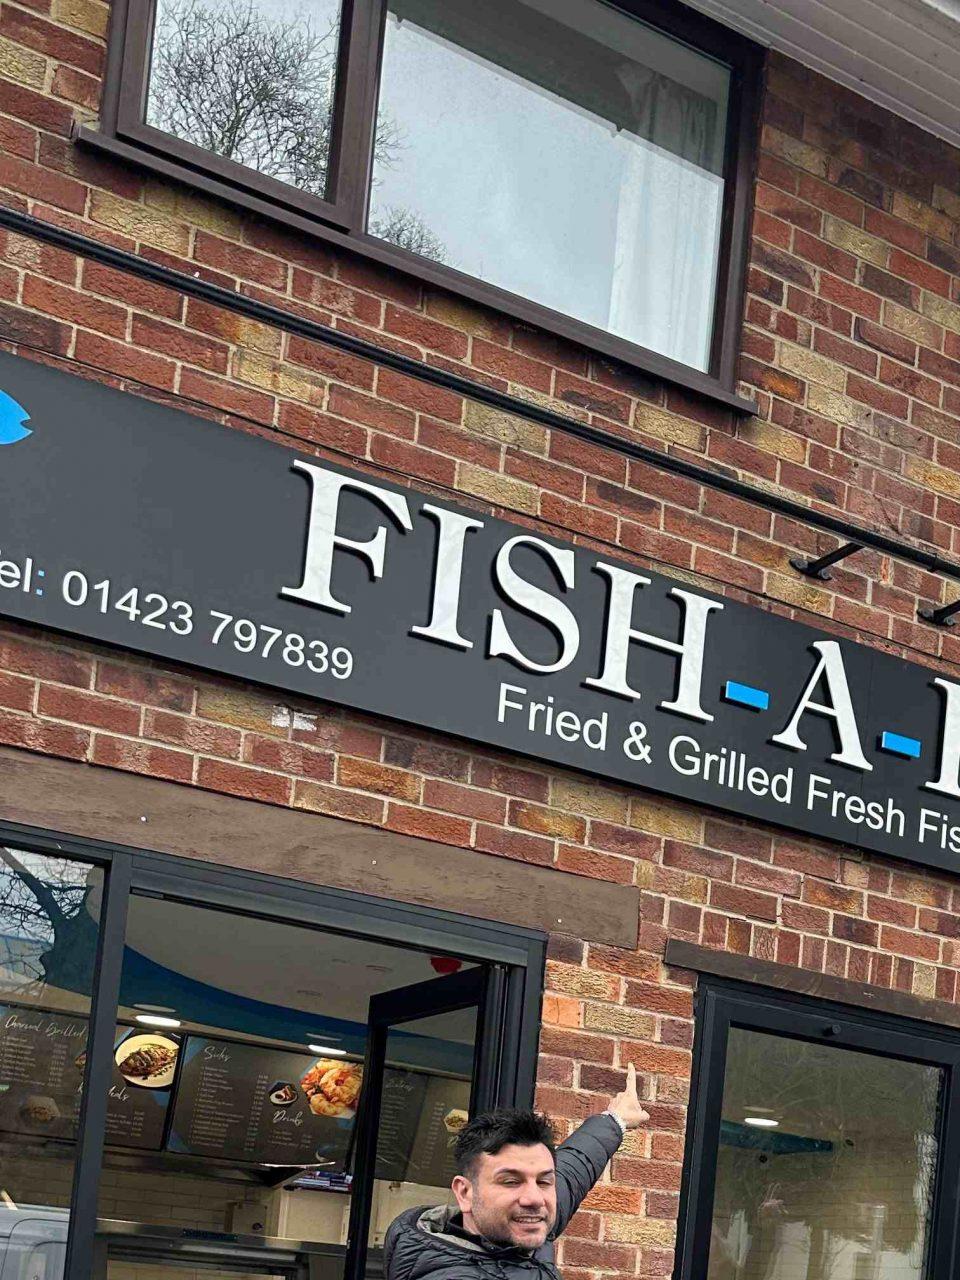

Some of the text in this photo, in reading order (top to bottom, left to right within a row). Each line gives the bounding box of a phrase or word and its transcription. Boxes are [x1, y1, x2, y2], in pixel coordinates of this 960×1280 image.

[0, 549, 354, 680] el: 01423 797839
[497, 682, 608, 752] Fried
[623, 721, 653, 765] &
[668, 735, 794, 804] Grilled
[807, 773, 906, 838] Fresh
